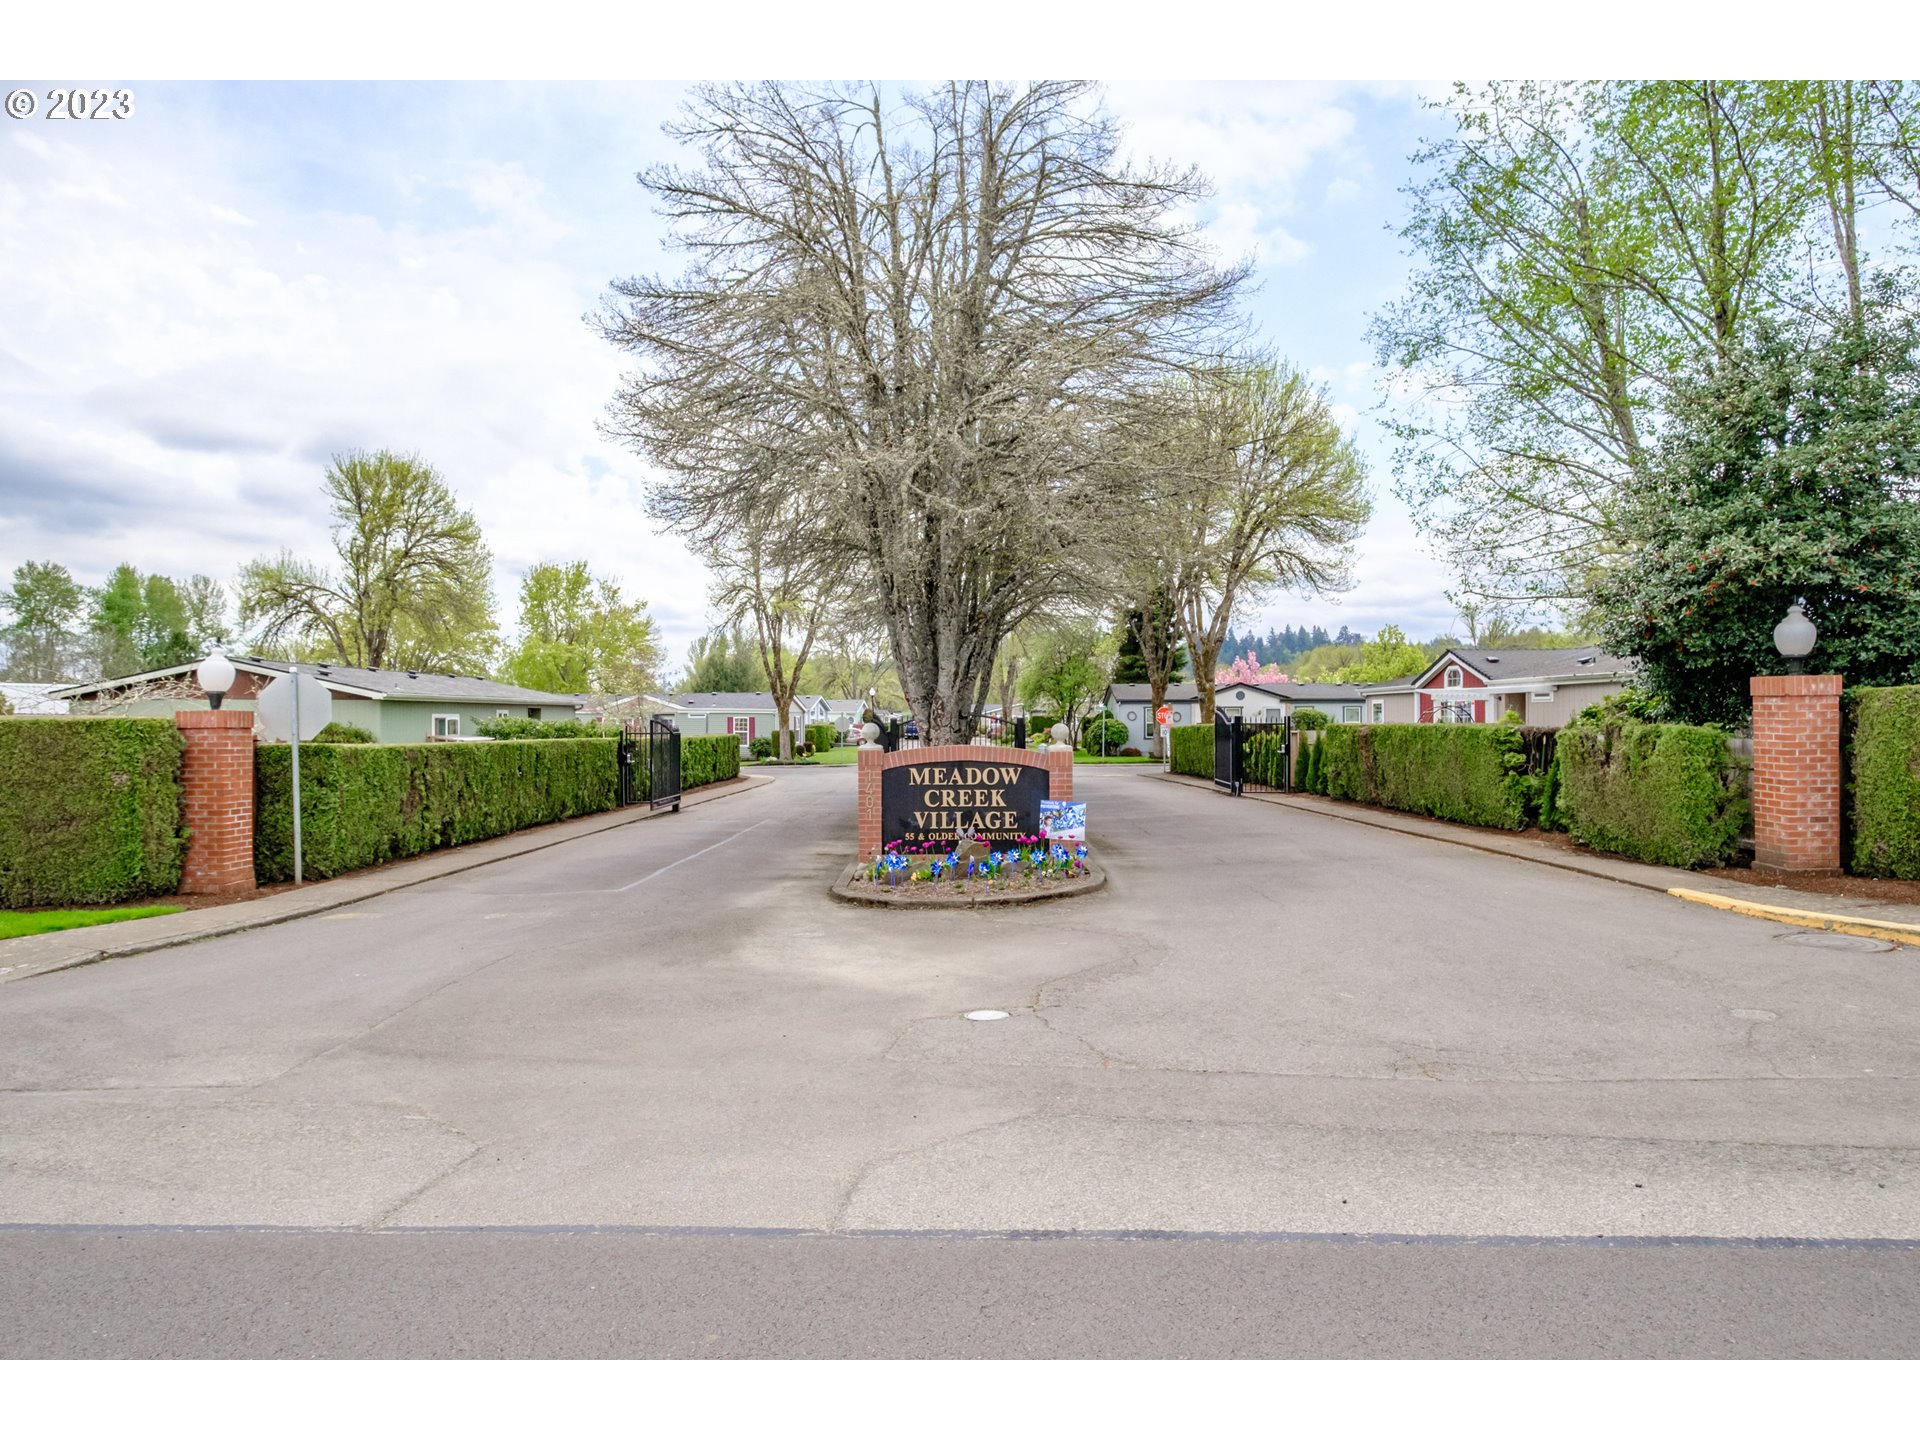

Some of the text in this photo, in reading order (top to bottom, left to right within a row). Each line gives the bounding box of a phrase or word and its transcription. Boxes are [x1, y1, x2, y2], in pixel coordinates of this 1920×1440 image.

[908, 767, 1022, 786] MEADOW
[924, 789, 1007, 807] CREEK
[913, 811, 1018, 829] VILLAGE
[905, 832, 1026, 841] 55 & OLDER COMMUNITY
